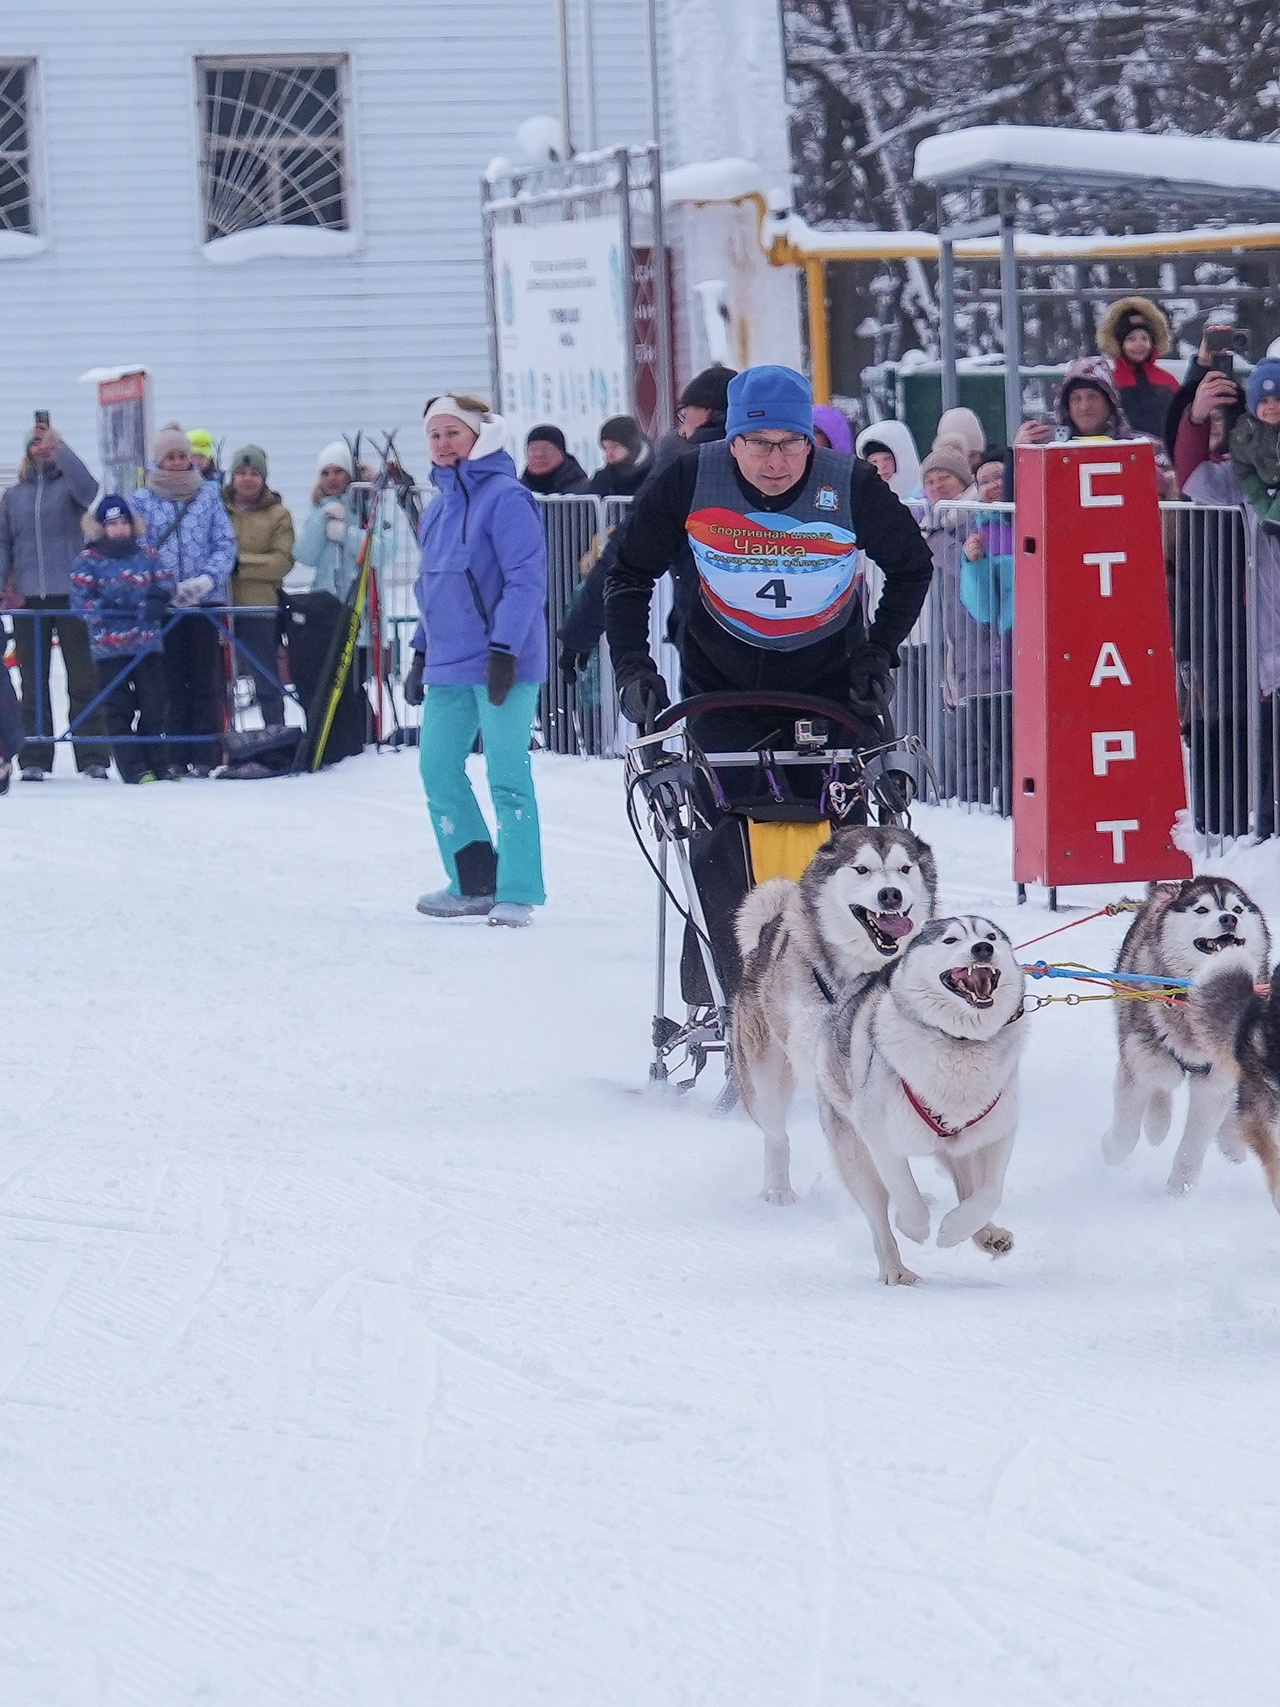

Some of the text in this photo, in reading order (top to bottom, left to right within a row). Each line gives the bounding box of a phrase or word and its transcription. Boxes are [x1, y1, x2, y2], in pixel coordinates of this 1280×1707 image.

[708, 524, 786, 540] Спортивная
[734, 539, 806, 557] Чайка
[756, 579, 792, 608] 4
[1078, 462, 1141, 865] СТАРТ
